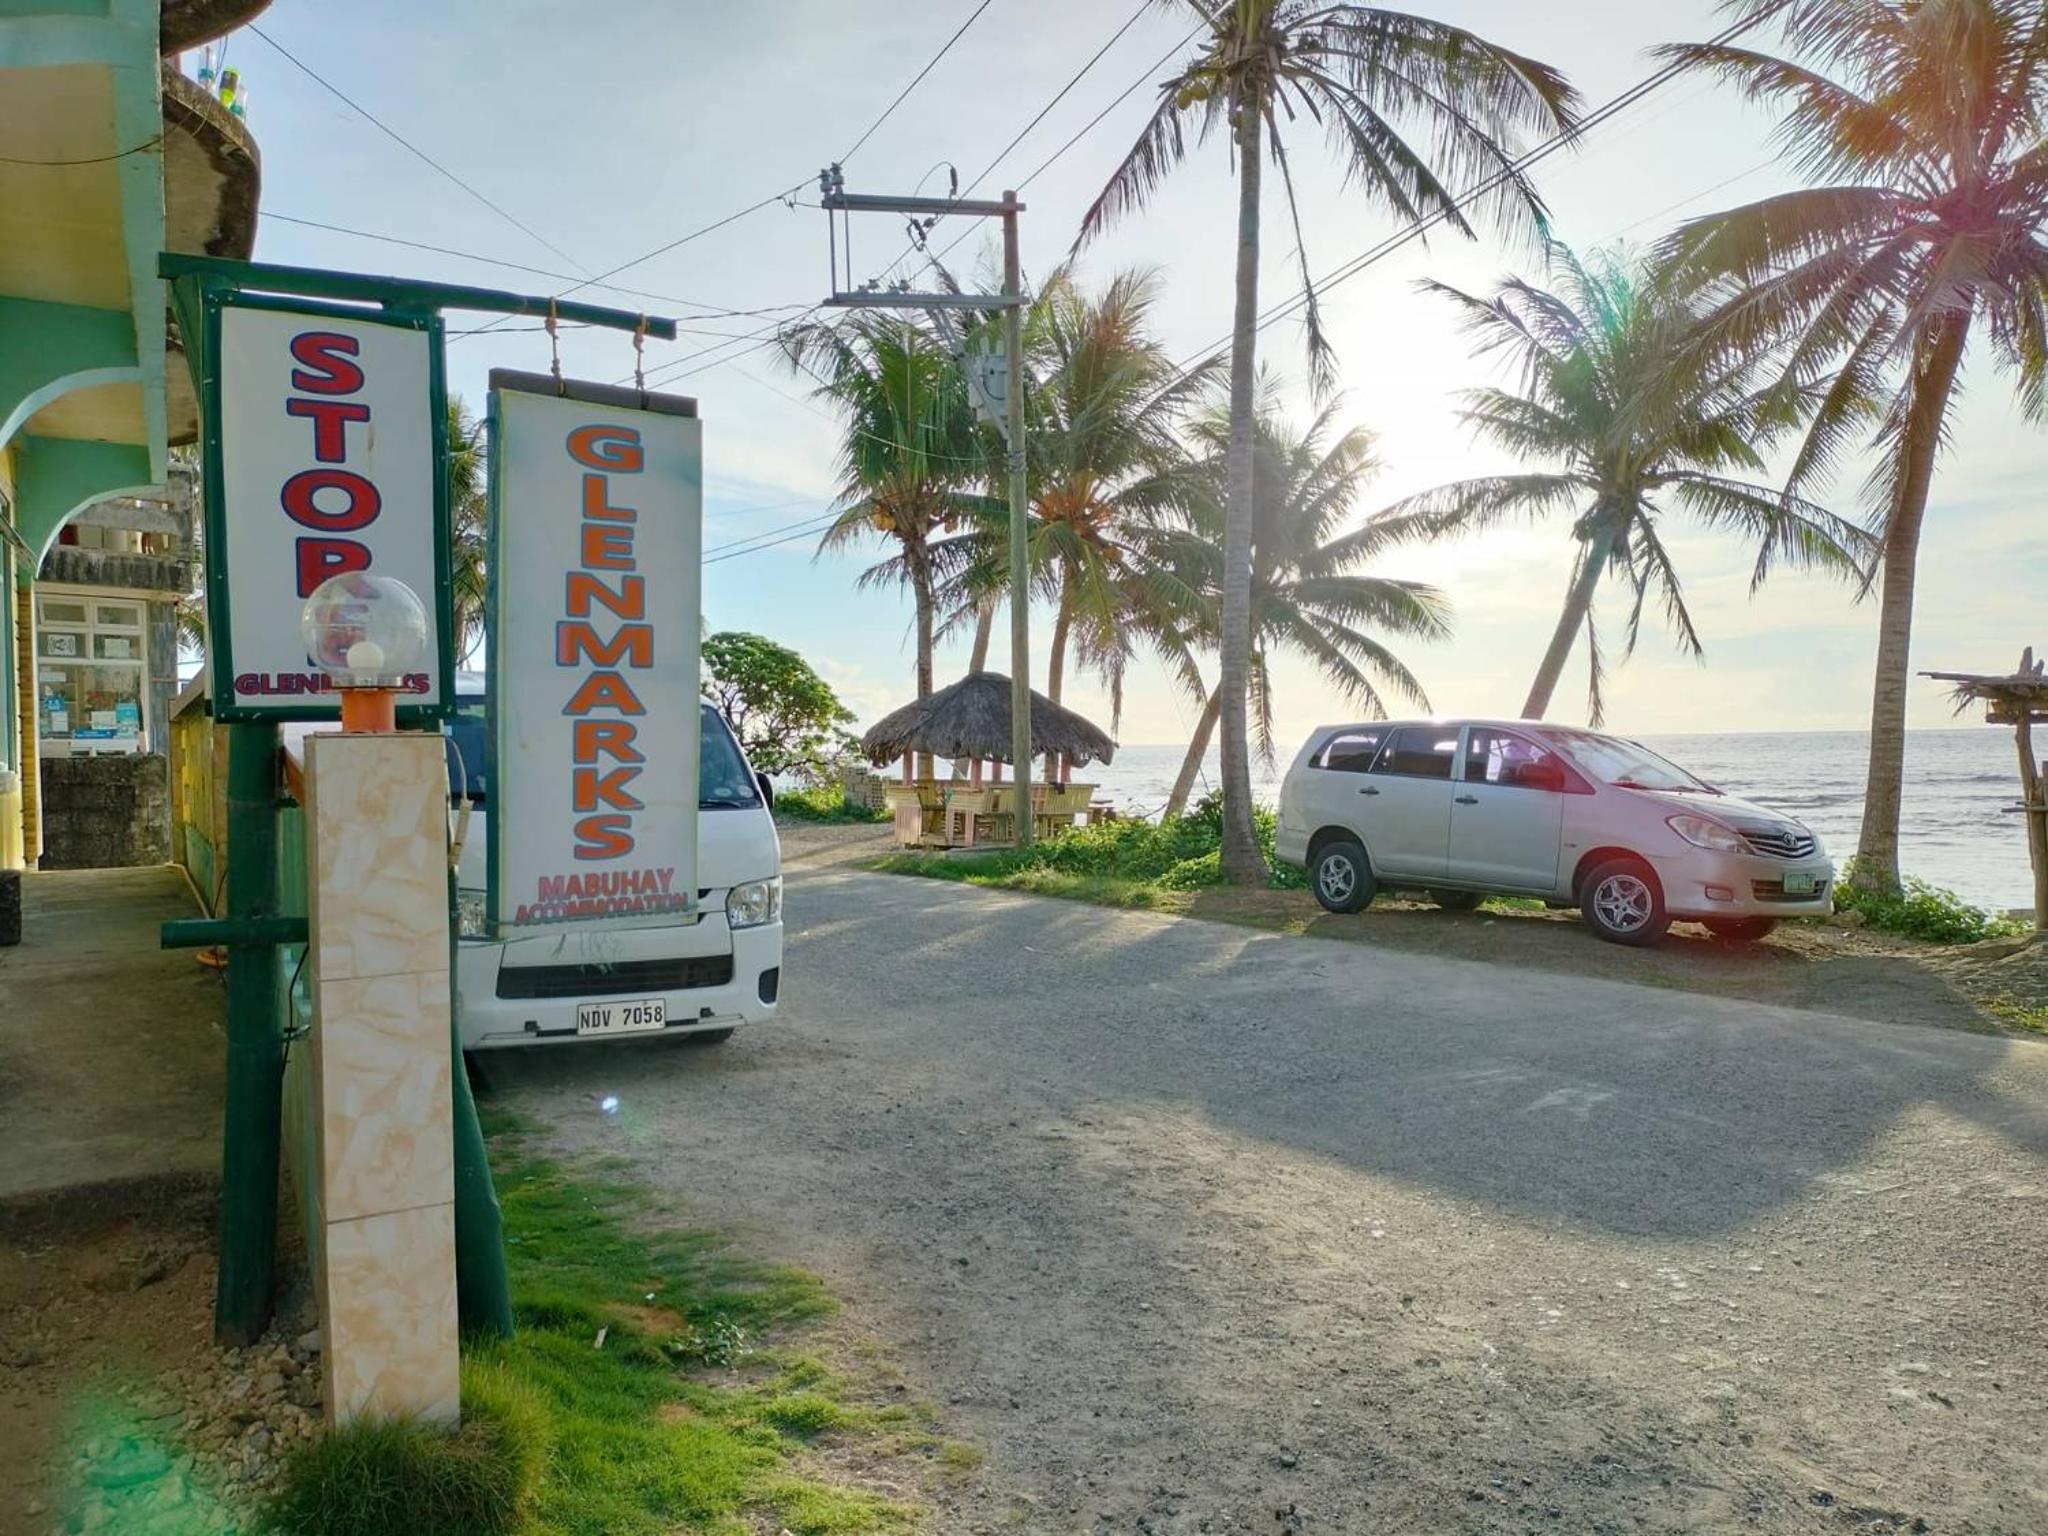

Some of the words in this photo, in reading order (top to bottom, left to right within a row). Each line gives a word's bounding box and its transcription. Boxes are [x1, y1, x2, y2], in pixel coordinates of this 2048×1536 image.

[554, 423, 654, 861] GLENMARKS
[537, 867, 675, 902] MABUHAY
[580, 1009, 611, 1029] NDV
[622, 1005, 663, 1026] 7058
